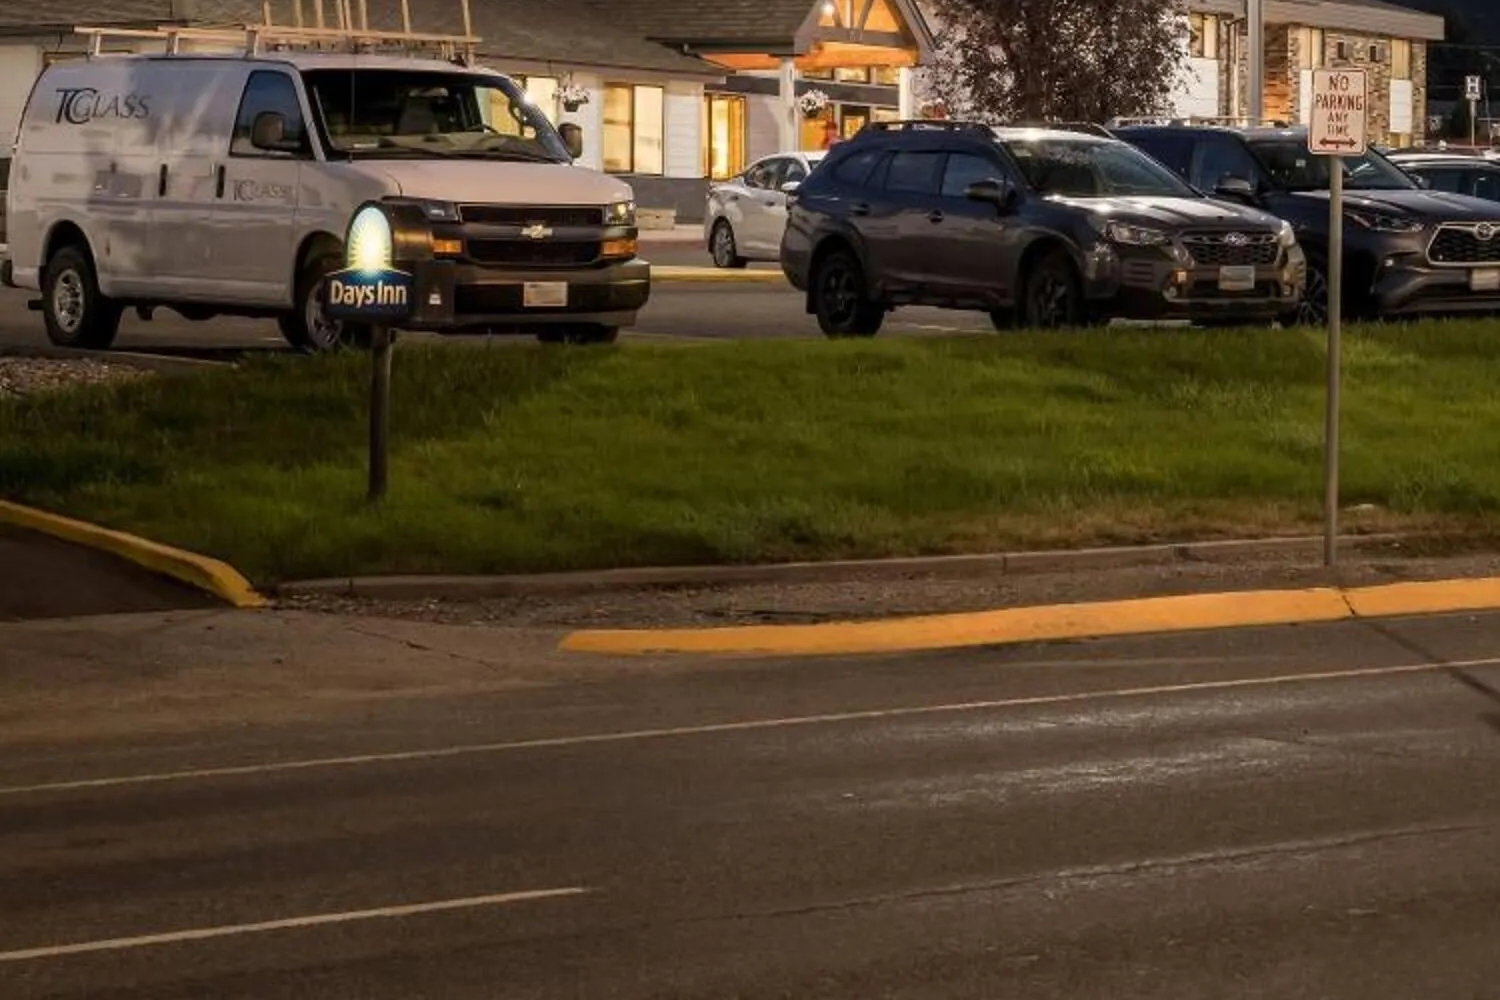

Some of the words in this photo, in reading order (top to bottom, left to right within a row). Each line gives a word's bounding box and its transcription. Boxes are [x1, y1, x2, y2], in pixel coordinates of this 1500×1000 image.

[1329, 74, 1349, 91] NO
[1316, 93, 1363, 110] PARKING
[1328, 111, 1348, 122] ANY
[331, 280, 375, 308] Days
[377, 280, 407, 304] Inn
